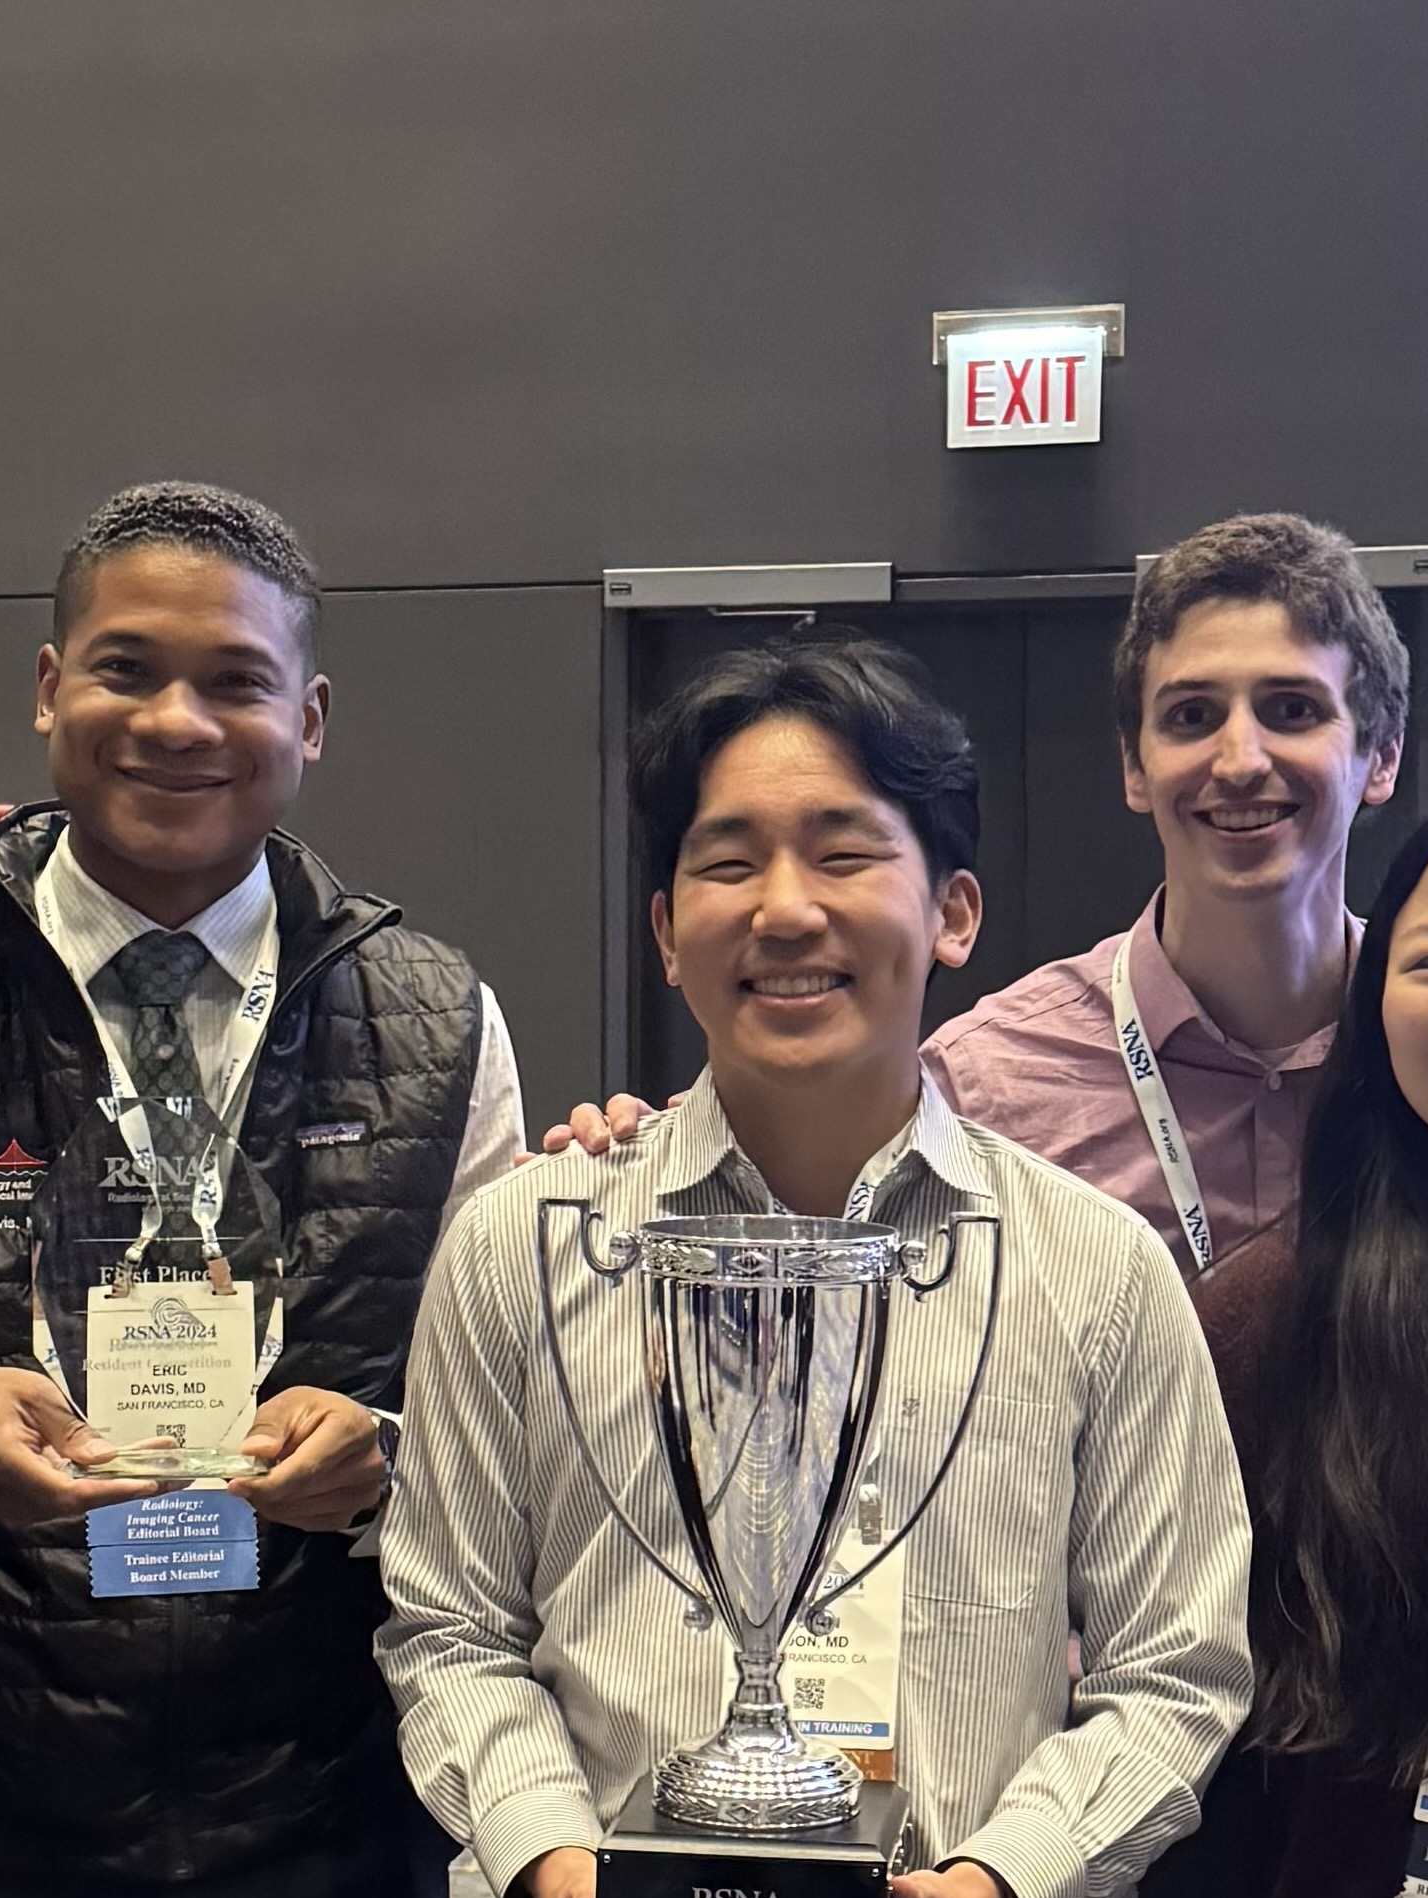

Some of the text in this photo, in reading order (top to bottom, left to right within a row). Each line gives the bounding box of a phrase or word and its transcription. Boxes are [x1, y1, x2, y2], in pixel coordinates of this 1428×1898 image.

[966, 355, 1086, 427] EXIT
[241, 970, 275, 1023] RSNA
[1121, 1018, 1155, 1081] RSNA
[1157, 1118, 1180, 1164] RSNA.org
[12, 1178, 32, 1189] and
[122, 1322, 217, 1341] RSNA 2024
[152, 1363, 188, 1377] ERIC
[130, 1382, 206, 1397] DAVIS, MD
[116, 1399, 224, 1412] SAN FRANCISCO, CA
[140, 1499, 204, 1512] Radiology:
[126, 1511, 220, 1528] Imaging Cancer
[127, 1524, 220, 1540] Editorial Board
[123, 1549, 225, 1567] Trainee Editorial
[129, 1568, 221, 1583] Board Member
[825, 1635, 849, 1648] MD
[788, 1652, 867, 1665] RANCISCO, CA
[813, 1722, 873, 1735] TRAINING
